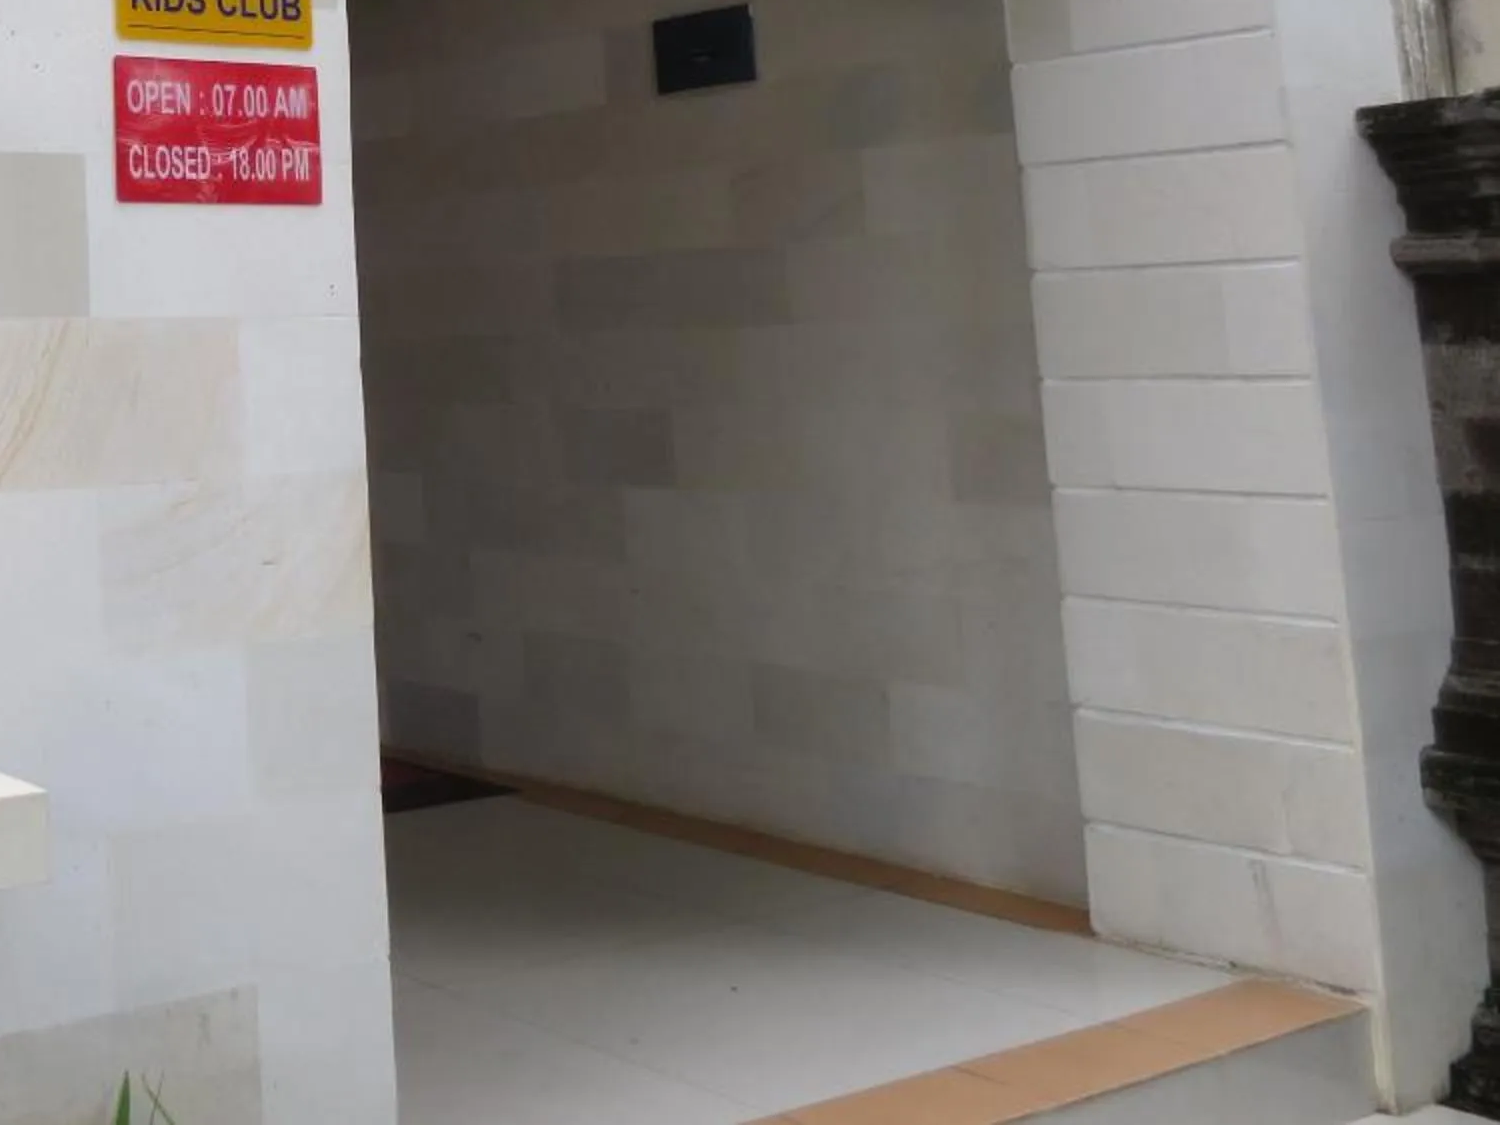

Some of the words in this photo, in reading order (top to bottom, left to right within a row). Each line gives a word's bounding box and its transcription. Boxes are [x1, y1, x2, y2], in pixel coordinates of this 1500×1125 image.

[127, 79, 191, 115] OPEN
[212, 83, 267, 118] 07.00
[274, 88, 308, 119] AM
[130, 144, 210, 180] CLOSED
[230, 148, 276, 182] 18.00
[283, 150, 309, 181] PM
